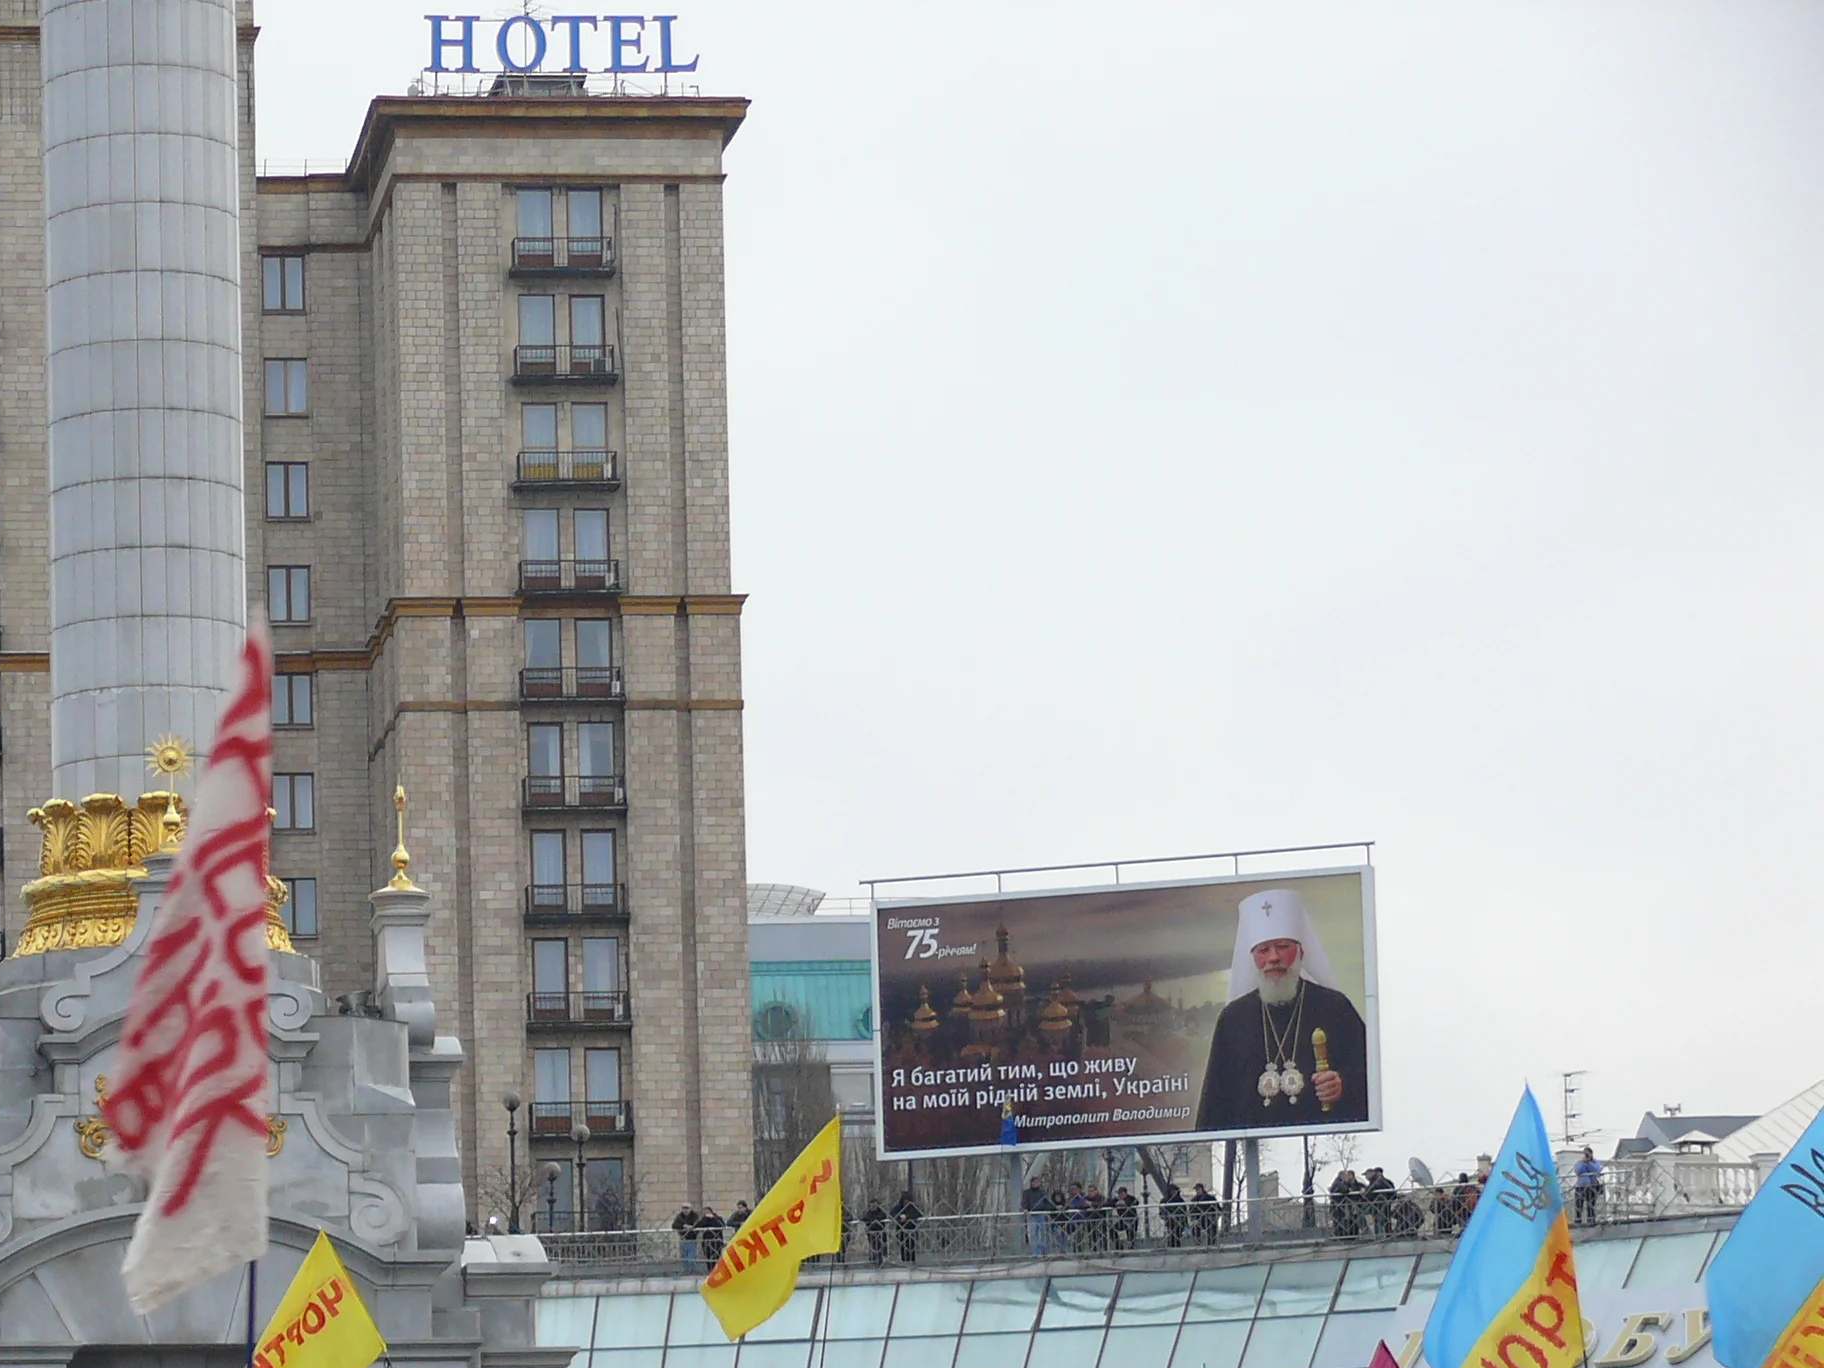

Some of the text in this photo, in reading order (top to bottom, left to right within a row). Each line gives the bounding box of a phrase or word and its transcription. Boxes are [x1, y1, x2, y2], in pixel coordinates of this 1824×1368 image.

[424, 15, 700, 73] HOTEL
[887, 916, 932, 930] Вітаємо
[891, 1057, 1137, 1088] Я багатий тим, що живу
[892, 1073, 1189, 1111] на моїй рідній землі, Україні
[1014, 1104, 1191, 1131] Митрополит Володимир
